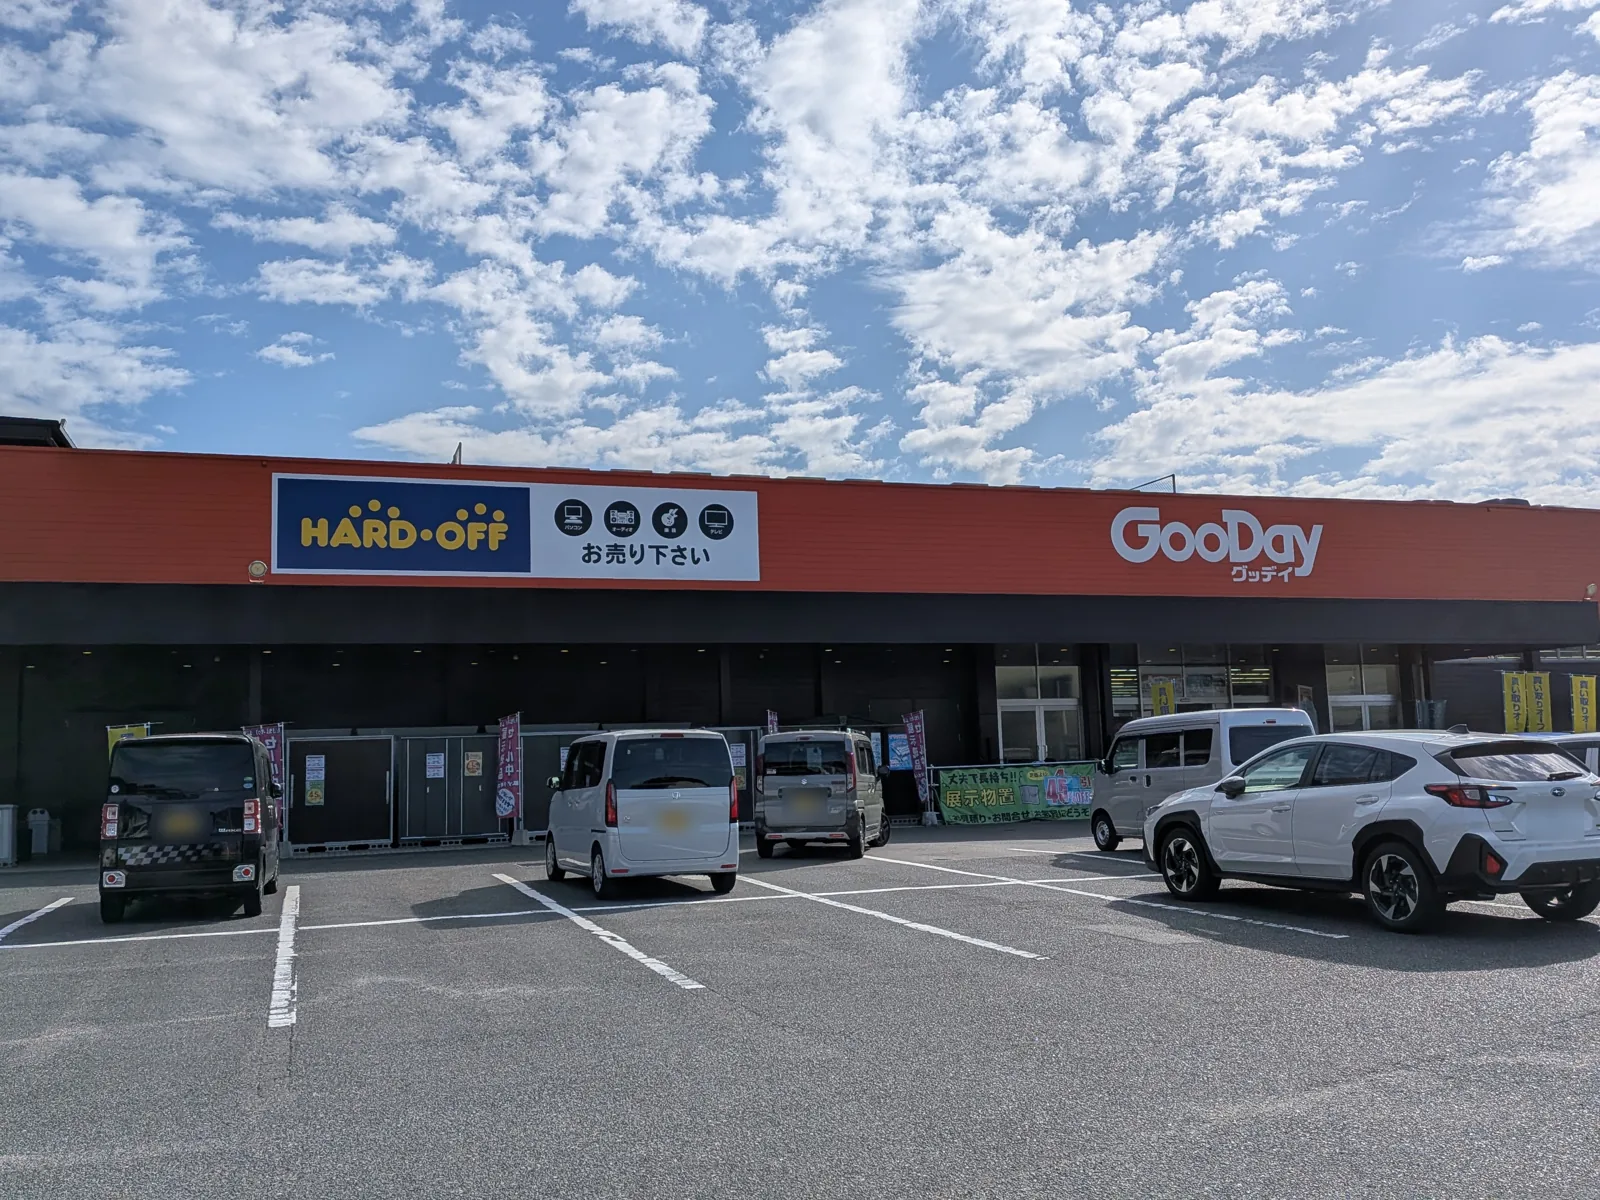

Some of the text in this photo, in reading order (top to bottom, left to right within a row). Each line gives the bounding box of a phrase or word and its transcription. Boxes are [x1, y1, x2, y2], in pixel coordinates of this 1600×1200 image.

[581, 542, 711, 566] お売り下さい
[1230, 565, 1294, 583] グッデイ
[947, 771, 1018, 786] 丈夫で長持ち!!
[945, 787, 1015, 808] 展示物置
